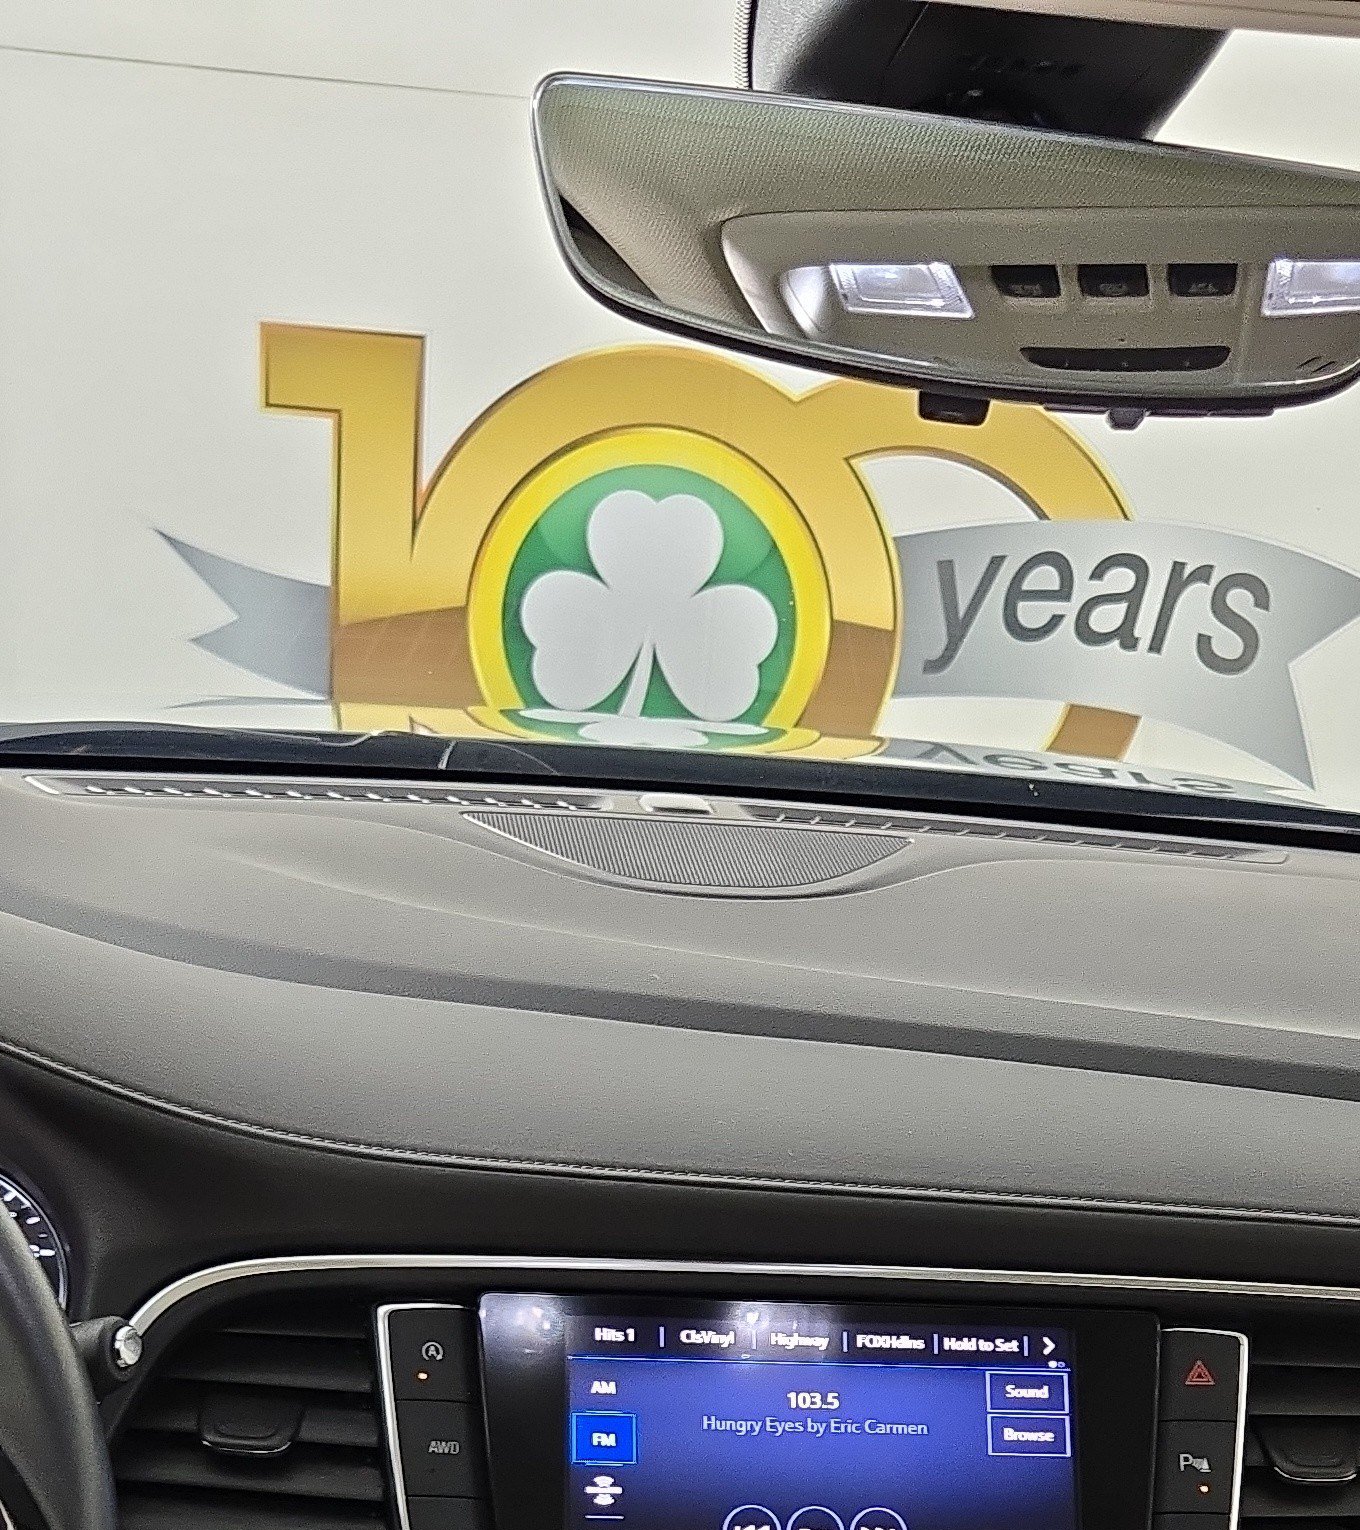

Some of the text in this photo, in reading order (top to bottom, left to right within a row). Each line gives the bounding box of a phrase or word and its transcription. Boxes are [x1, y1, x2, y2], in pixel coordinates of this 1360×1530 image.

[922, 549, 1271, 676] years
[594, 1328, 635, 1341] Hits 1
[770, 1332, 829, 1350] Highway
[943, 1337, 1020, 1352] Hold to Set
[591, 1381, 617, 1394] AM
[1005, 1384, 1049, 1400] Sound
[787, 1391, 840, 1409] 103.5
[702, 1416, 928, 1437] Hungry Eyes by Eric Carmen
[592, 1432, 617, 1446] FM
[1003, 1428, 1055, 1442] Browse
[428, 1441, 460, 1455] AWD
